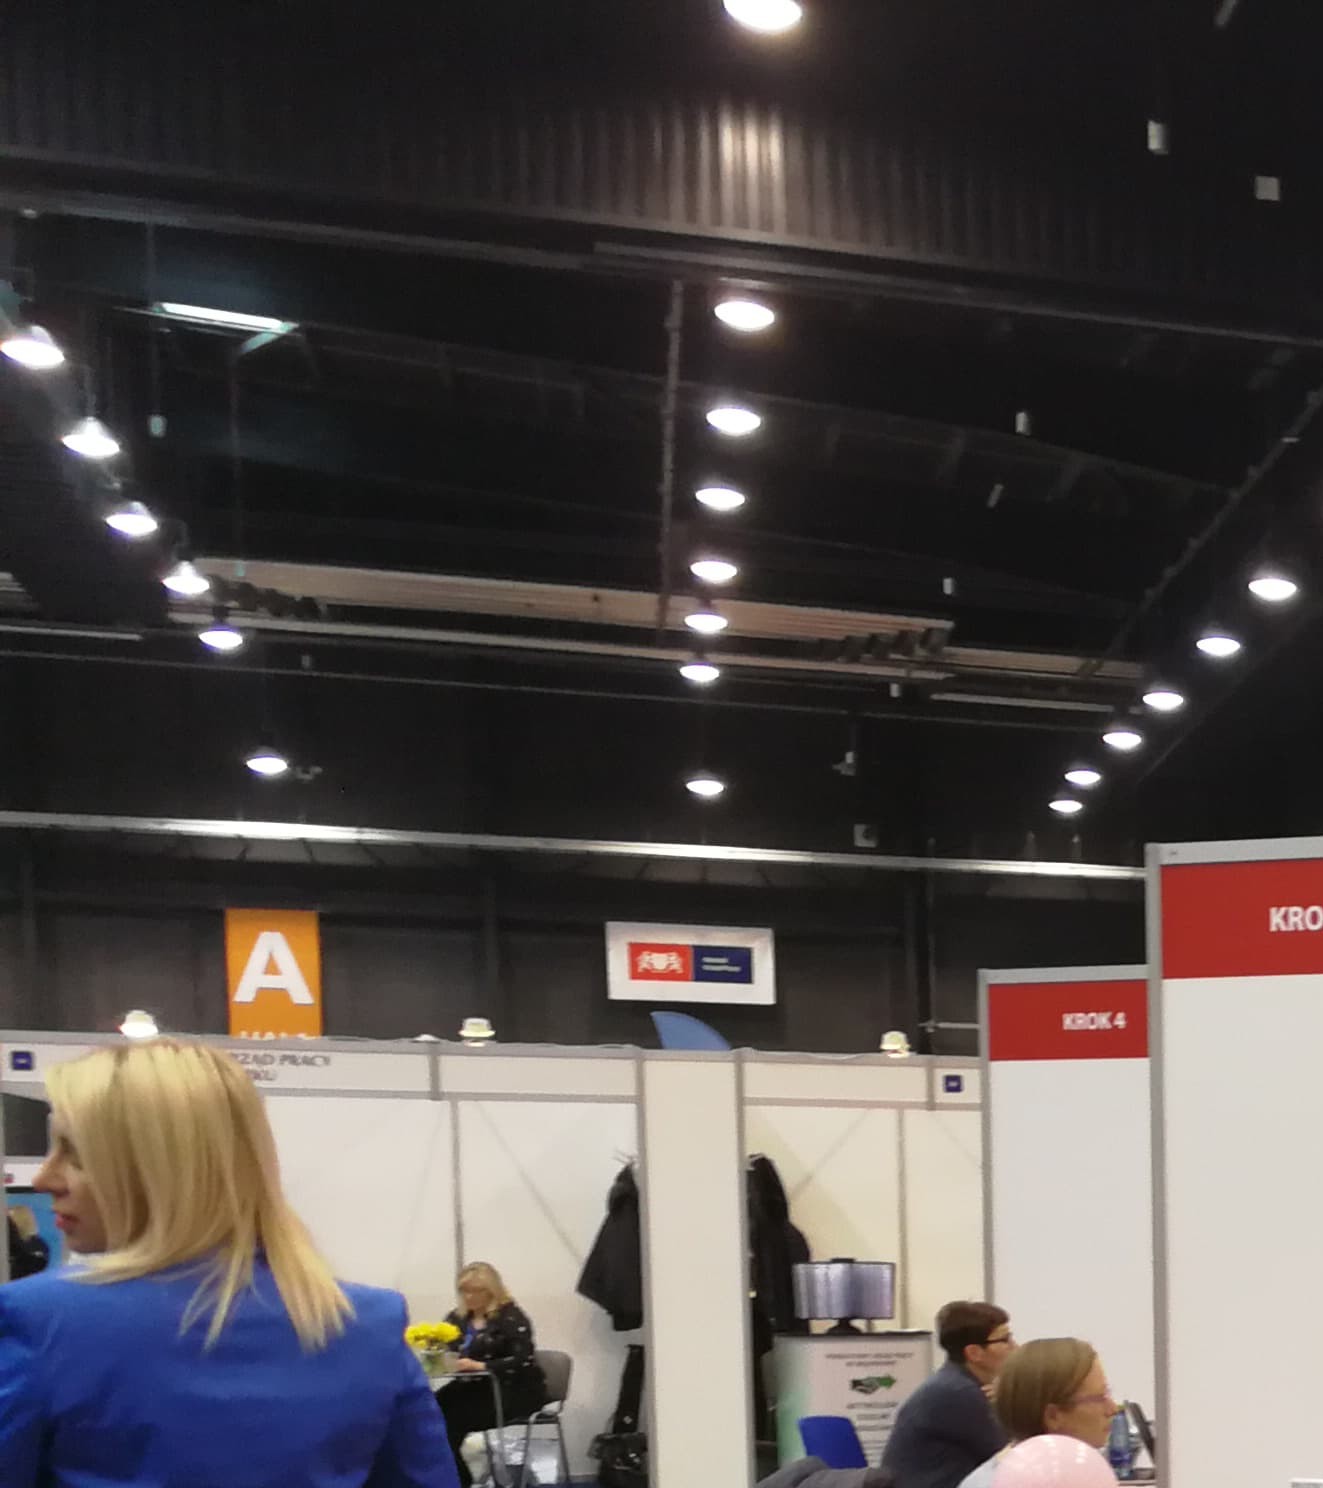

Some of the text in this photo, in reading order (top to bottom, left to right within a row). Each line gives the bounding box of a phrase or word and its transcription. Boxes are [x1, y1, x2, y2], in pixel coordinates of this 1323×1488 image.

[233, 931, 315, 1005] A
[1062, 1011, 1127, 1030] KROK 4
